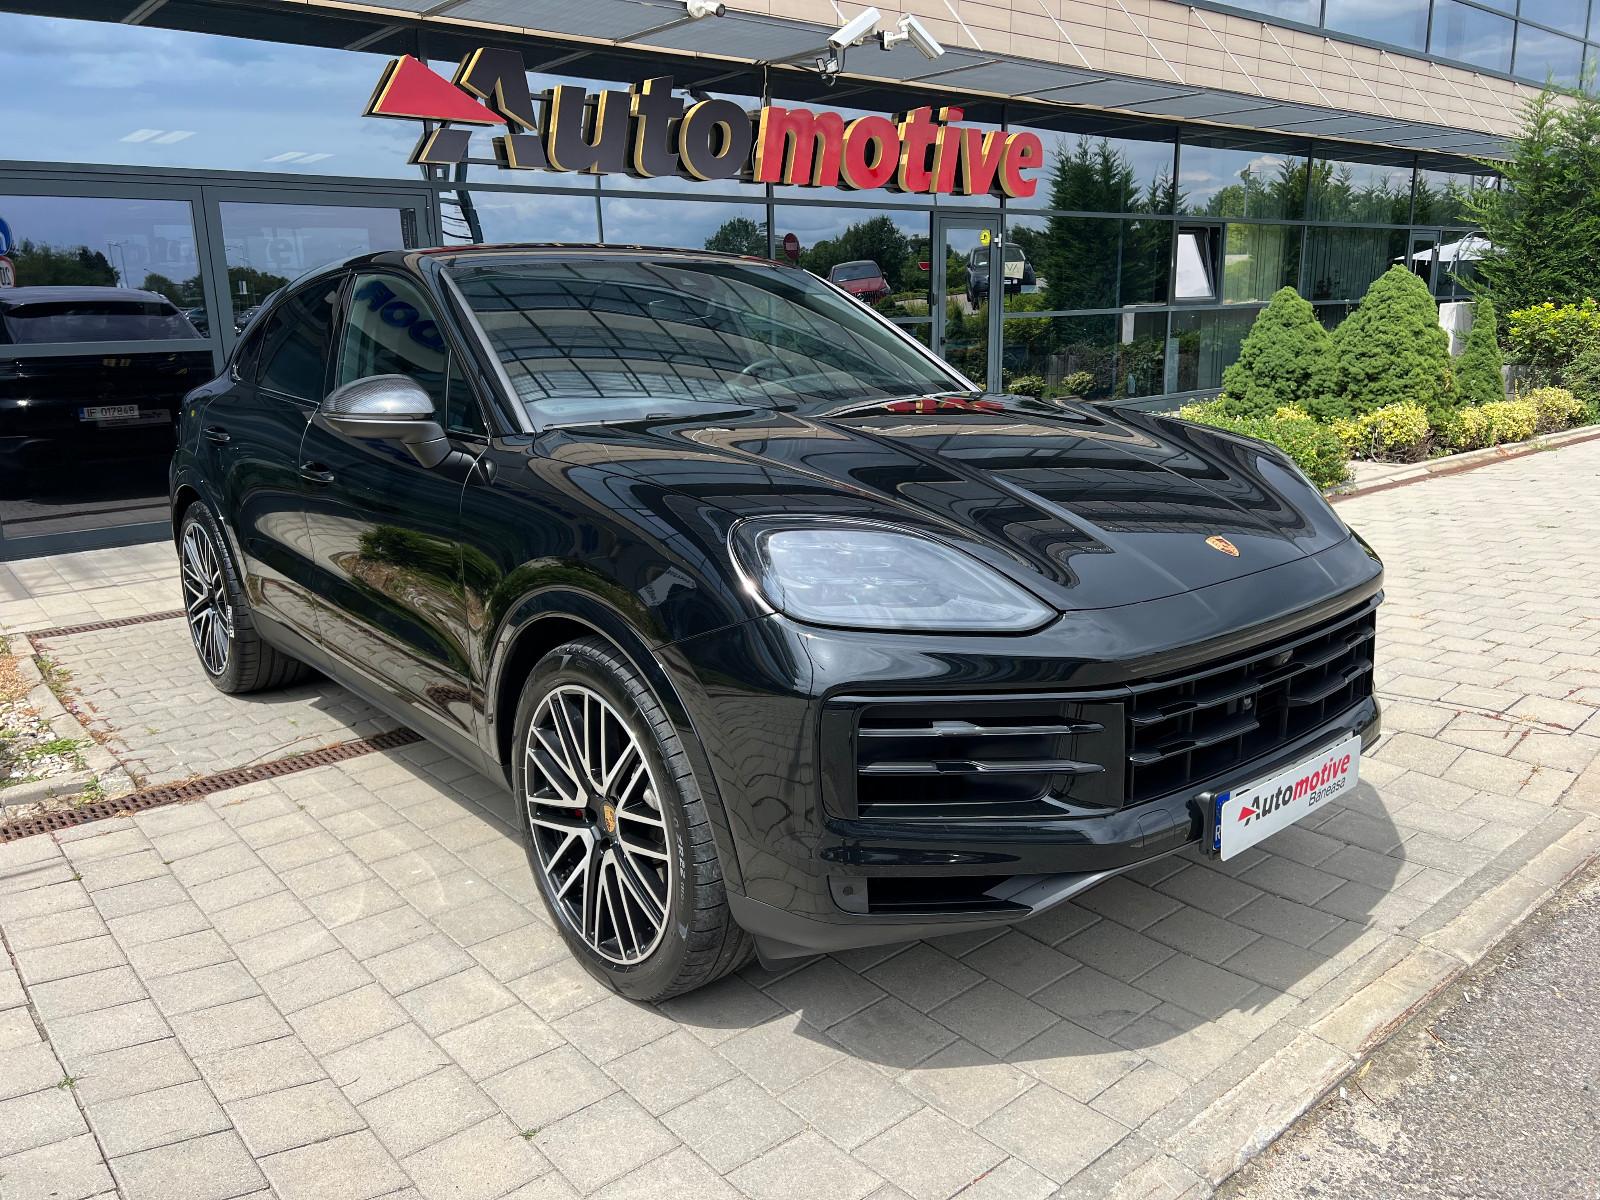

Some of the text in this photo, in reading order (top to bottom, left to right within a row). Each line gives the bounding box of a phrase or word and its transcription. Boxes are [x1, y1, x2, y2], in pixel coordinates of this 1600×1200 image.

[362, 46, 1043, 198] Automotive
[1238, 754, 1351, 826] Automotive
[1308, 777, 1346, 807] Baneasa
